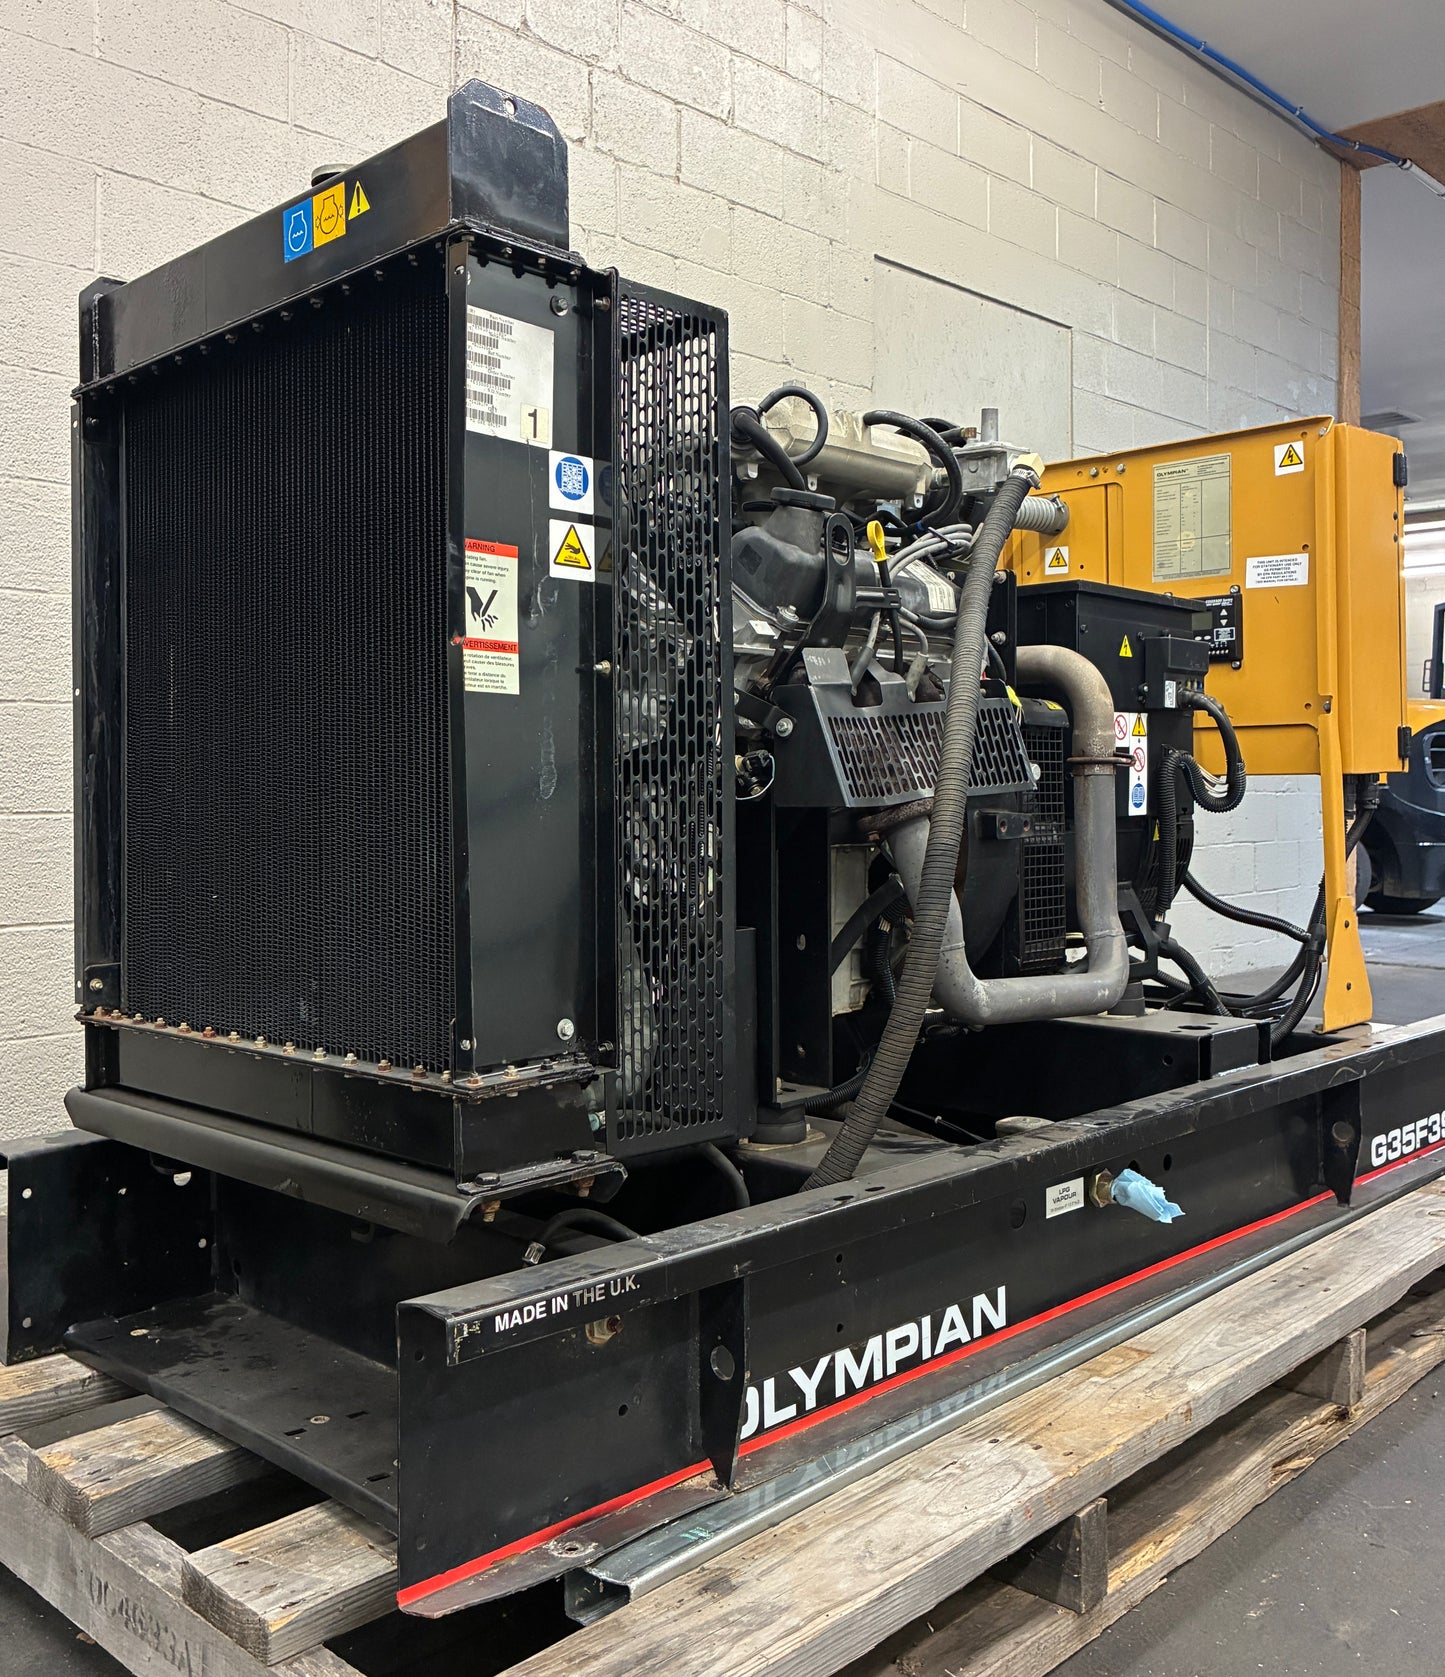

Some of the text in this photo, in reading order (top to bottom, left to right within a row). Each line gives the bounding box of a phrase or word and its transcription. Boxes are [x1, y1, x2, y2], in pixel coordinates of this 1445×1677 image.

[527, 408, 537, 439] 1
[1156, 469, 1186, 477] OLYMPIAN
[1371, 1109, 1445, 1168] G35F3
[1052, 1191, 1077, 1204] VAPOUR
[1058, 1186, 1070, 1195] LPG
[494, 1274, 641, 1333] MADE IN THE U.K.
